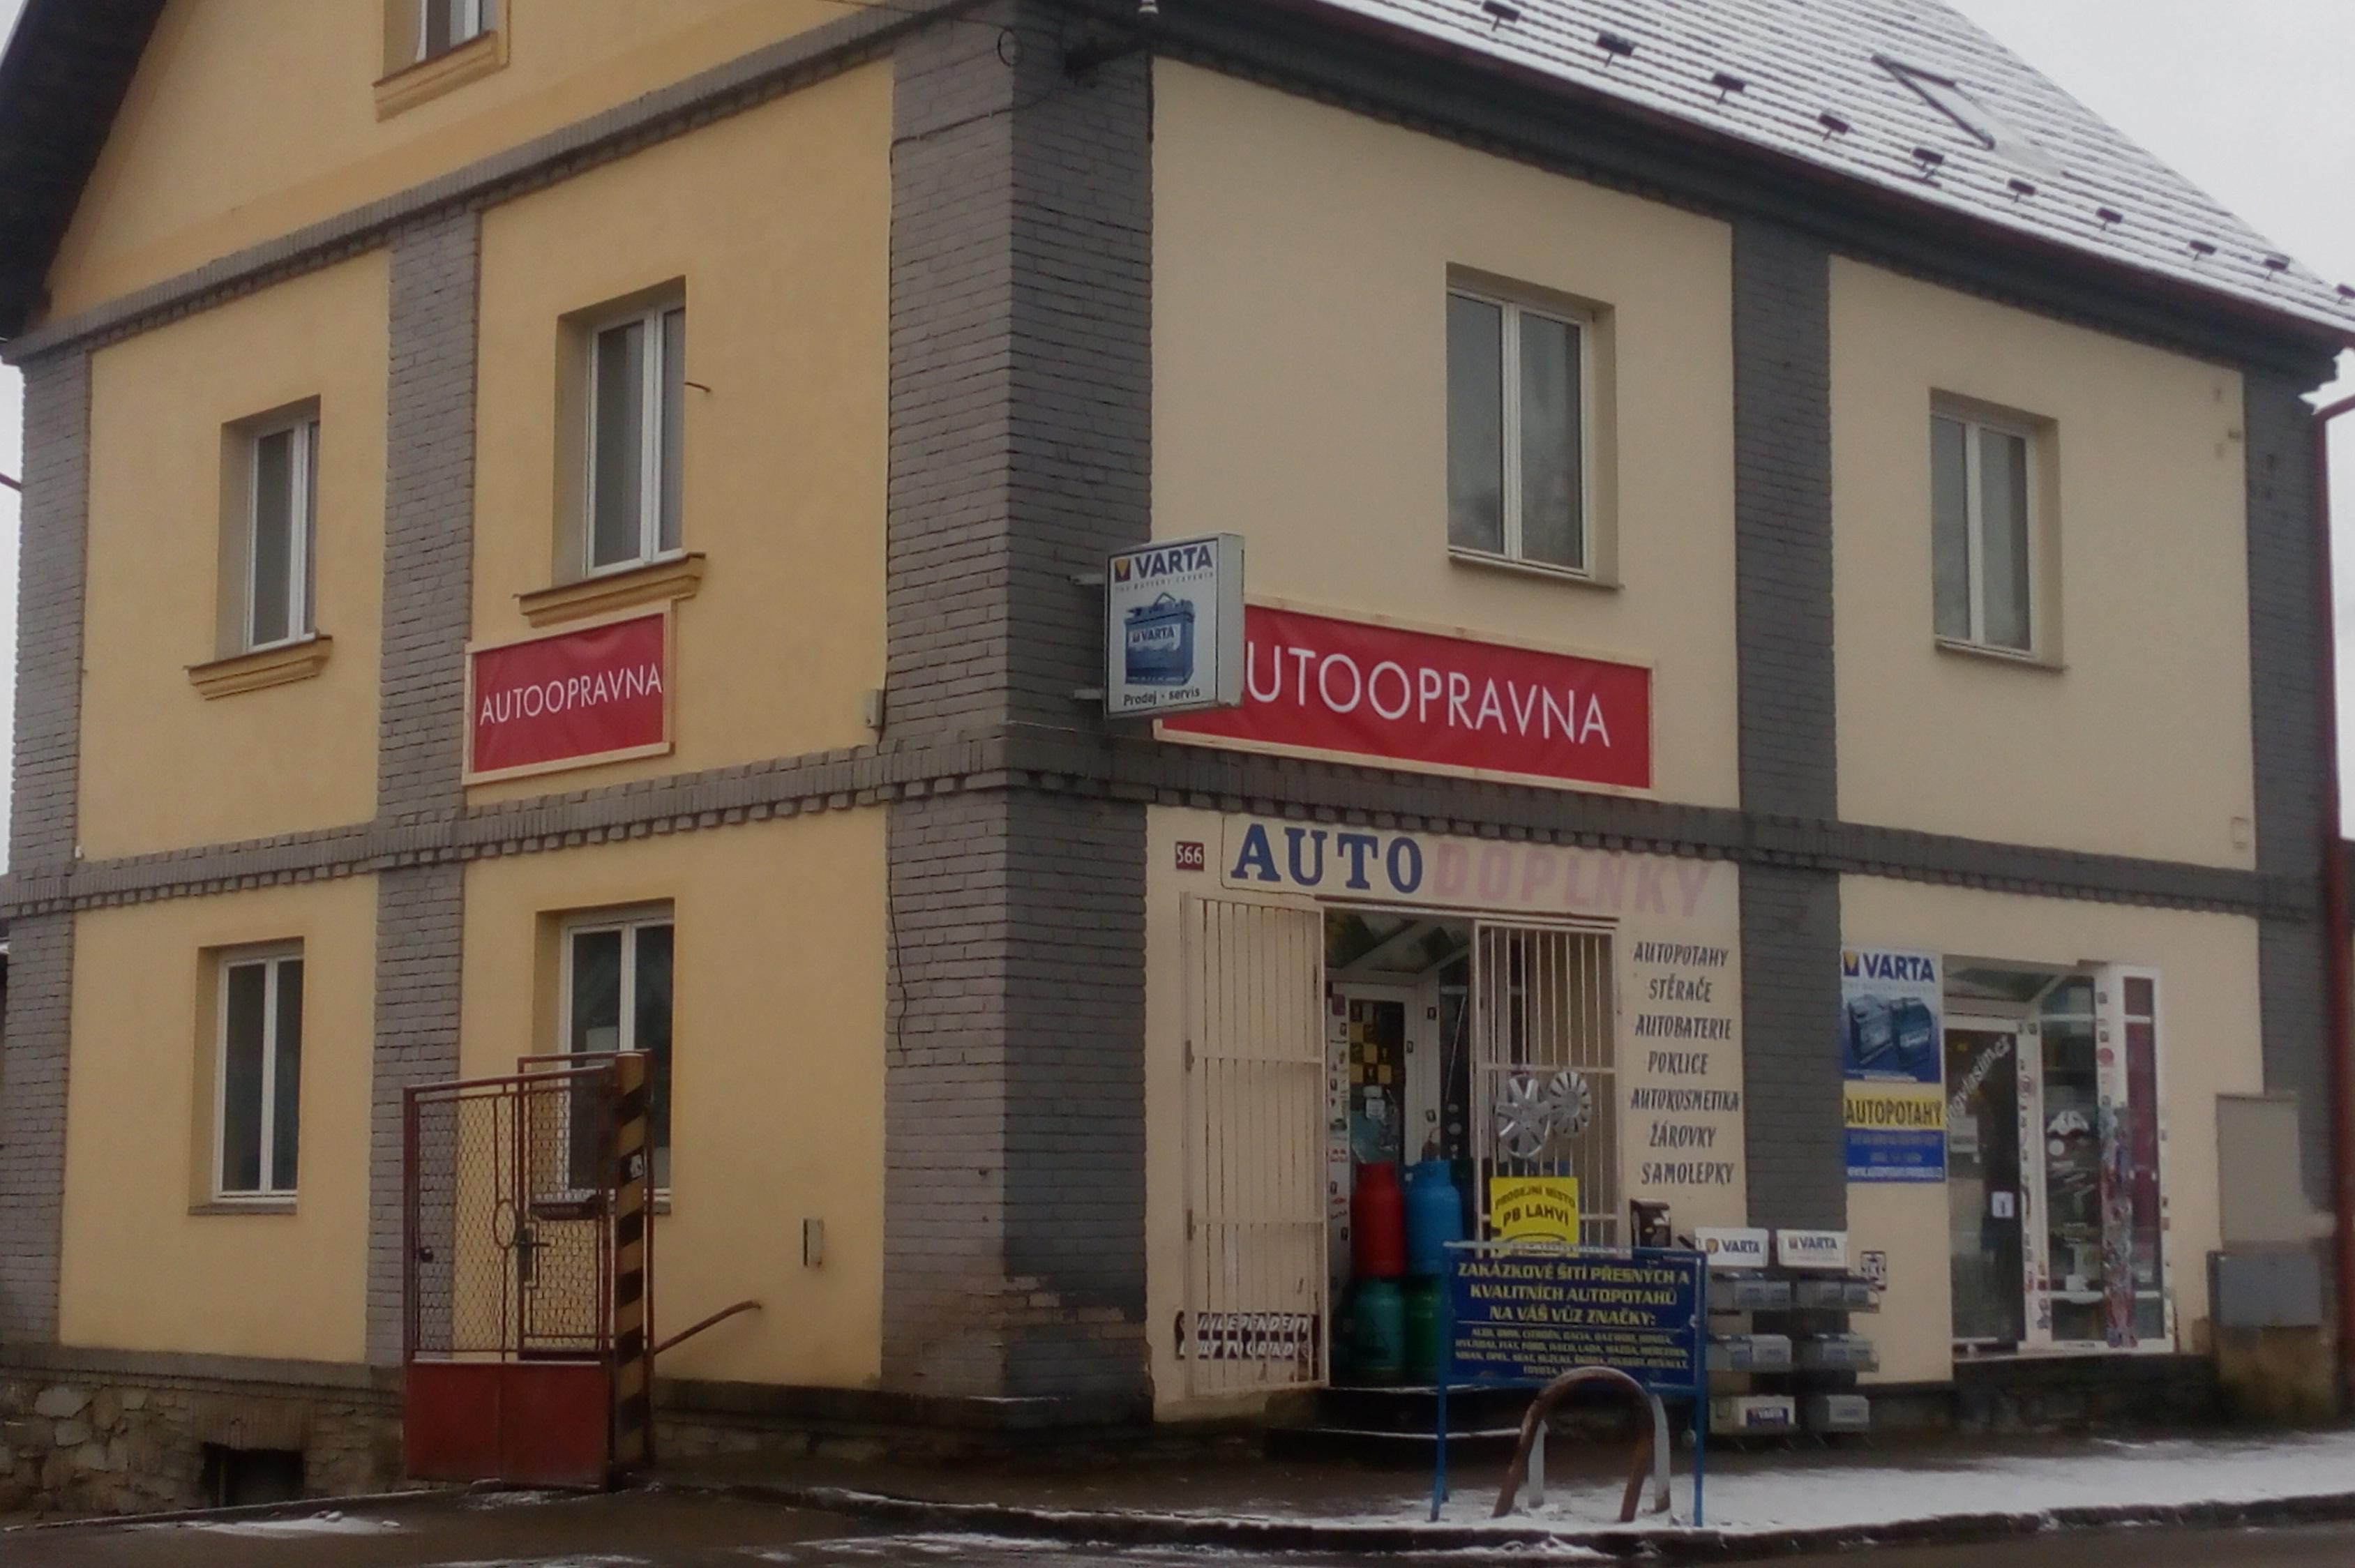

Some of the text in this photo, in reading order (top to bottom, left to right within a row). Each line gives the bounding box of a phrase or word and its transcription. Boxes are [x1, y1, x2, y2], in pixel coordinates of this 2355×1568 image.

[1135, 545, 1213, 578] VARTA
[1139, 626, 1175, 642] VARTA
[480, 663, 663, 726] AUTOOPRAVNA
[1124, 691, 1157, 707] Prodej
[1168, 687, 1201, 701] servis
[1247, 641, 1610, 748] UTOOPRAVNA
[1176, 843, 1203, 865] 566
[1231, 823, 1423, 894] AUTO
[1634, 942, 1729, 967] AUTOPOTAHY
[1863, 952, 1935, 983] VARTA
[1648, 973, 1713, 1003] STĚRAČE
[1635, 1013, 1731, 1040] AUTOBATERIE
[1648, 1050, 1708, 1075] POKLICE
[1630, 1088, 1740, 1112] AUTOKOSMETIKA
[1846, 1099, 1942, 1126] AUTOPOTAHY
[1641, 1162, 1735, 1185] SAMOLEPKY
[1503, 1207, 1521, 1228] PB
[1722, 1239, 1760, 1254] VARTA
[1800, 1236, 1837, 1250] VARTA
[1678, 1270, 1690, 1285] A
[1490, 1304, 1513, 1320] NA
